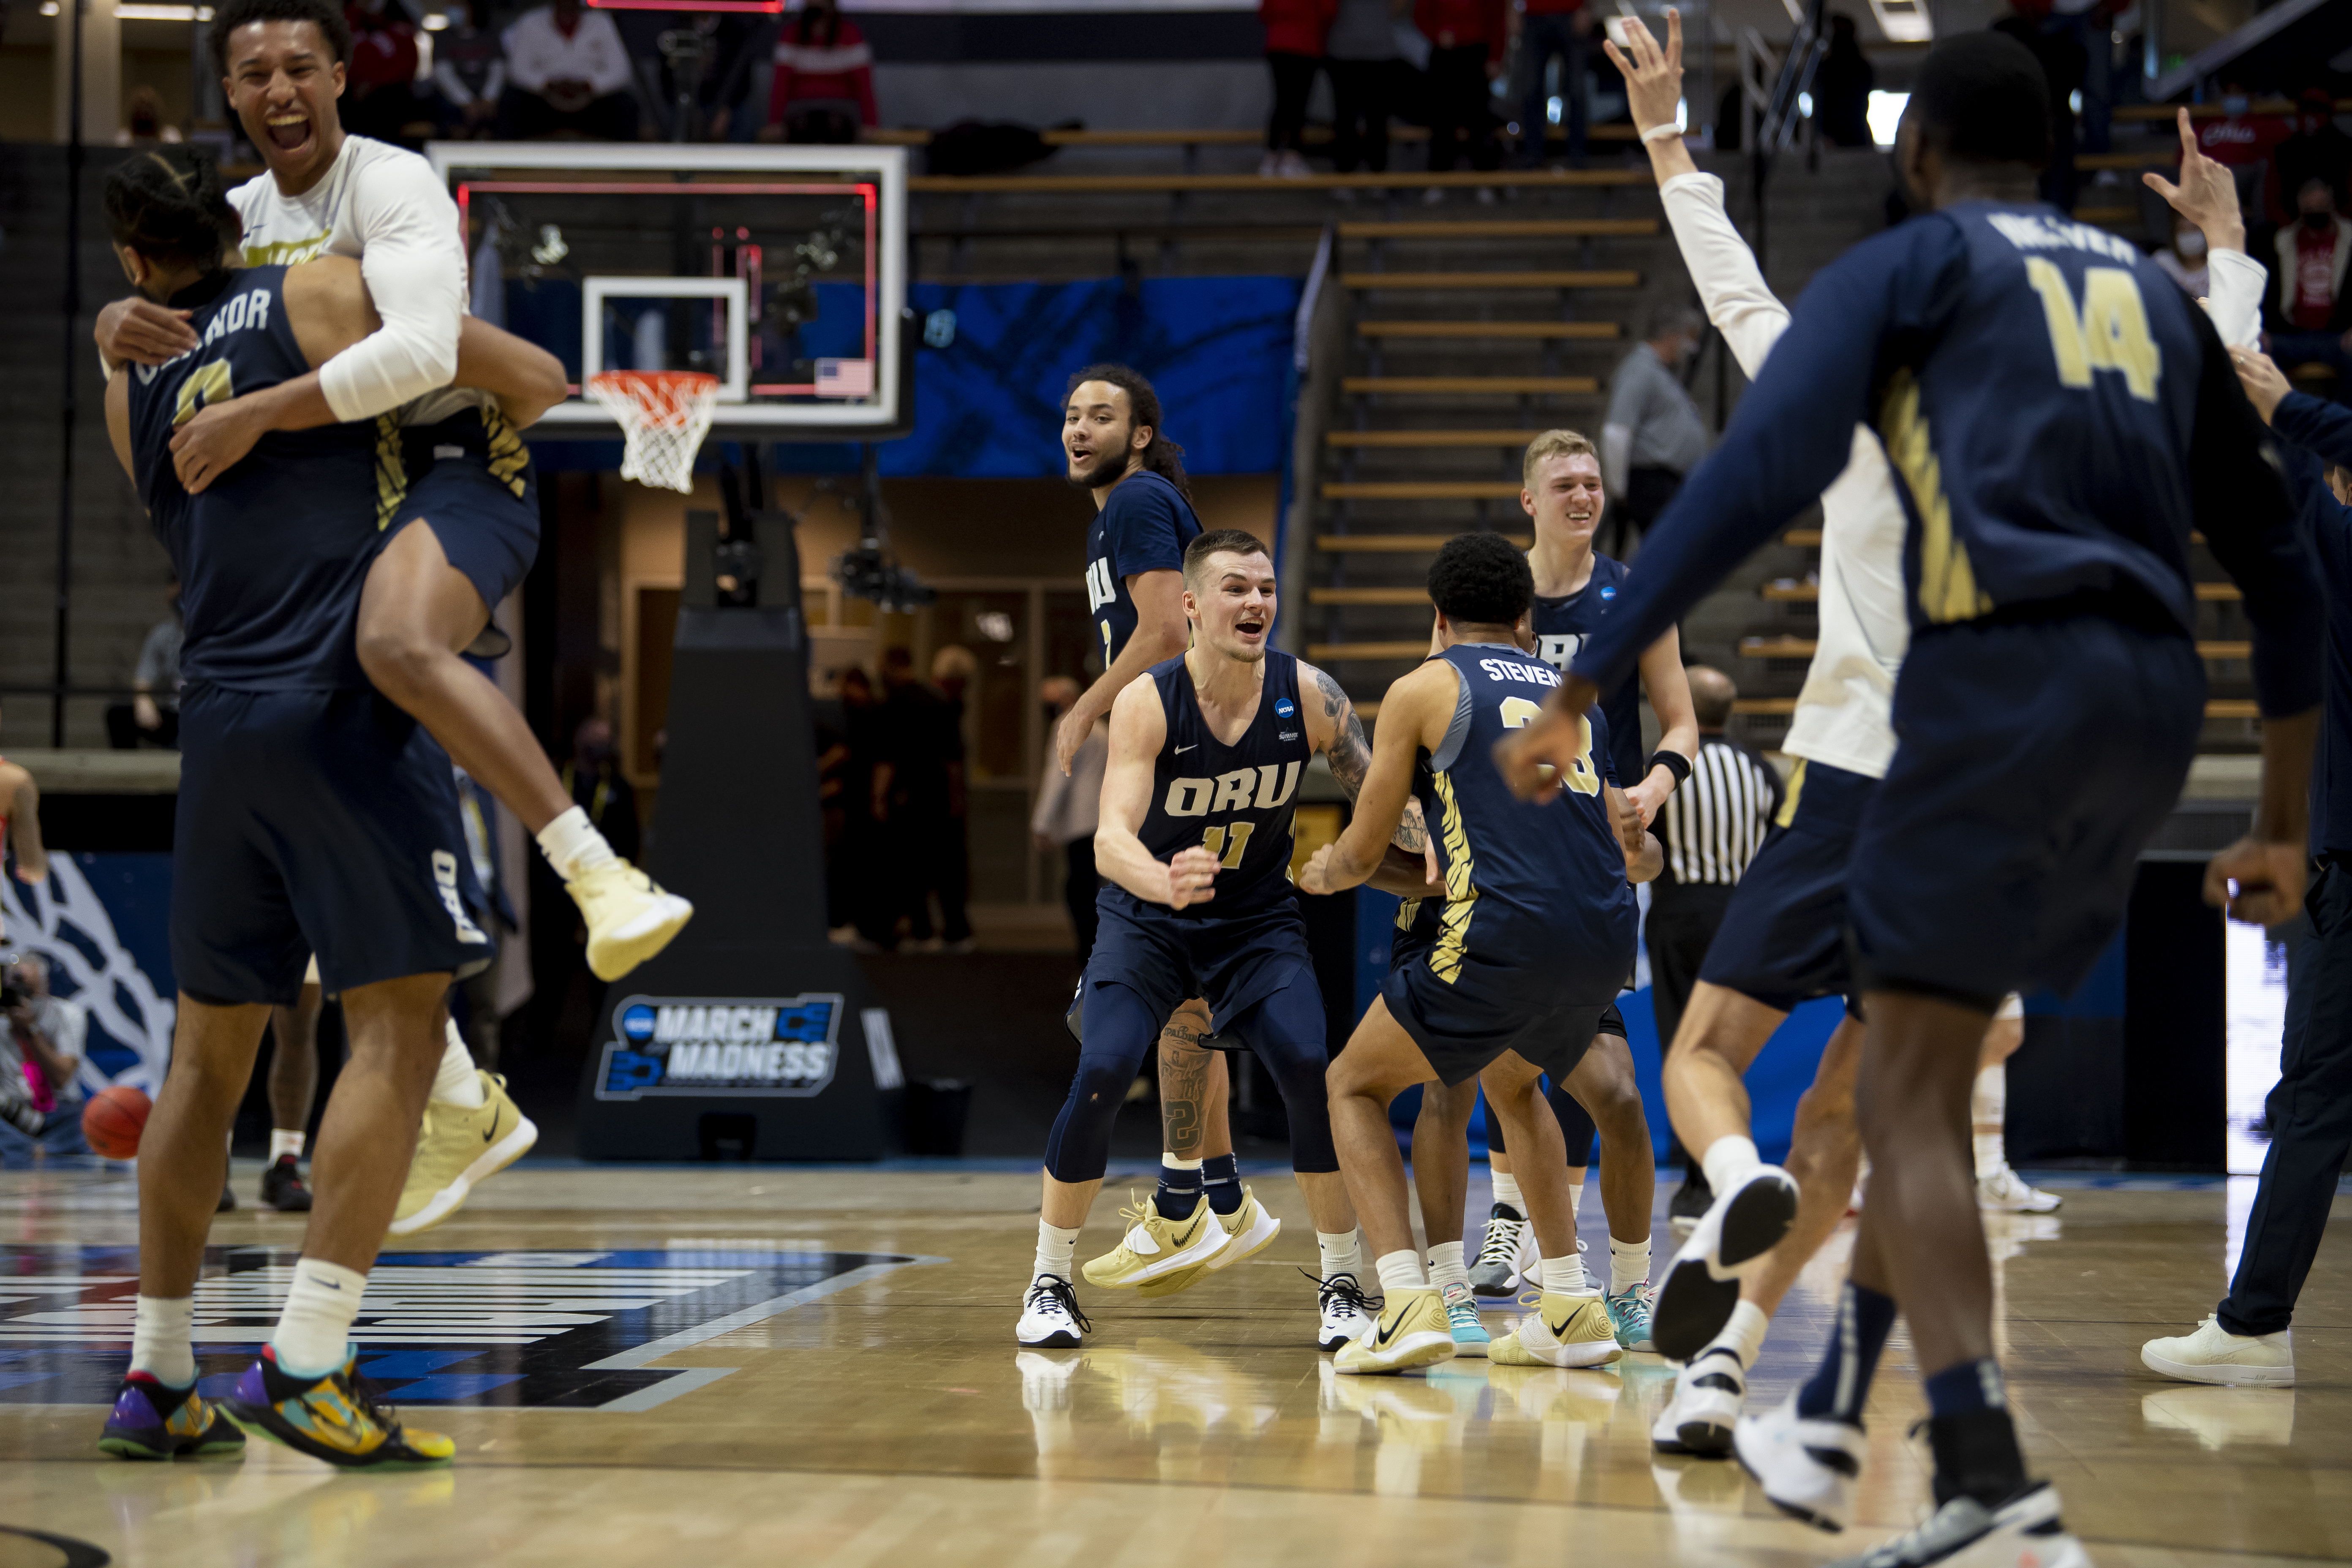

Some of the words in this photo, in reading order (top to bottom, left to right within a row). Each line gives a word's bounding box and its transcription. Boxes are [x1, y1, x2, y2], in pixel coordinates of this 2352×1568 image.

[2023, 255, 2162, 404] 14
[1279, 706, 1293, 714] NCAA
[1164, 760, 1301, 817] ORU
[1202, 822, 1255, 869] 11
[653, 1005, 779, 1043] MARCH
[665, 1041, 831, 1080] MADNESS
[1165, 1099, 1201, 1151] 2
